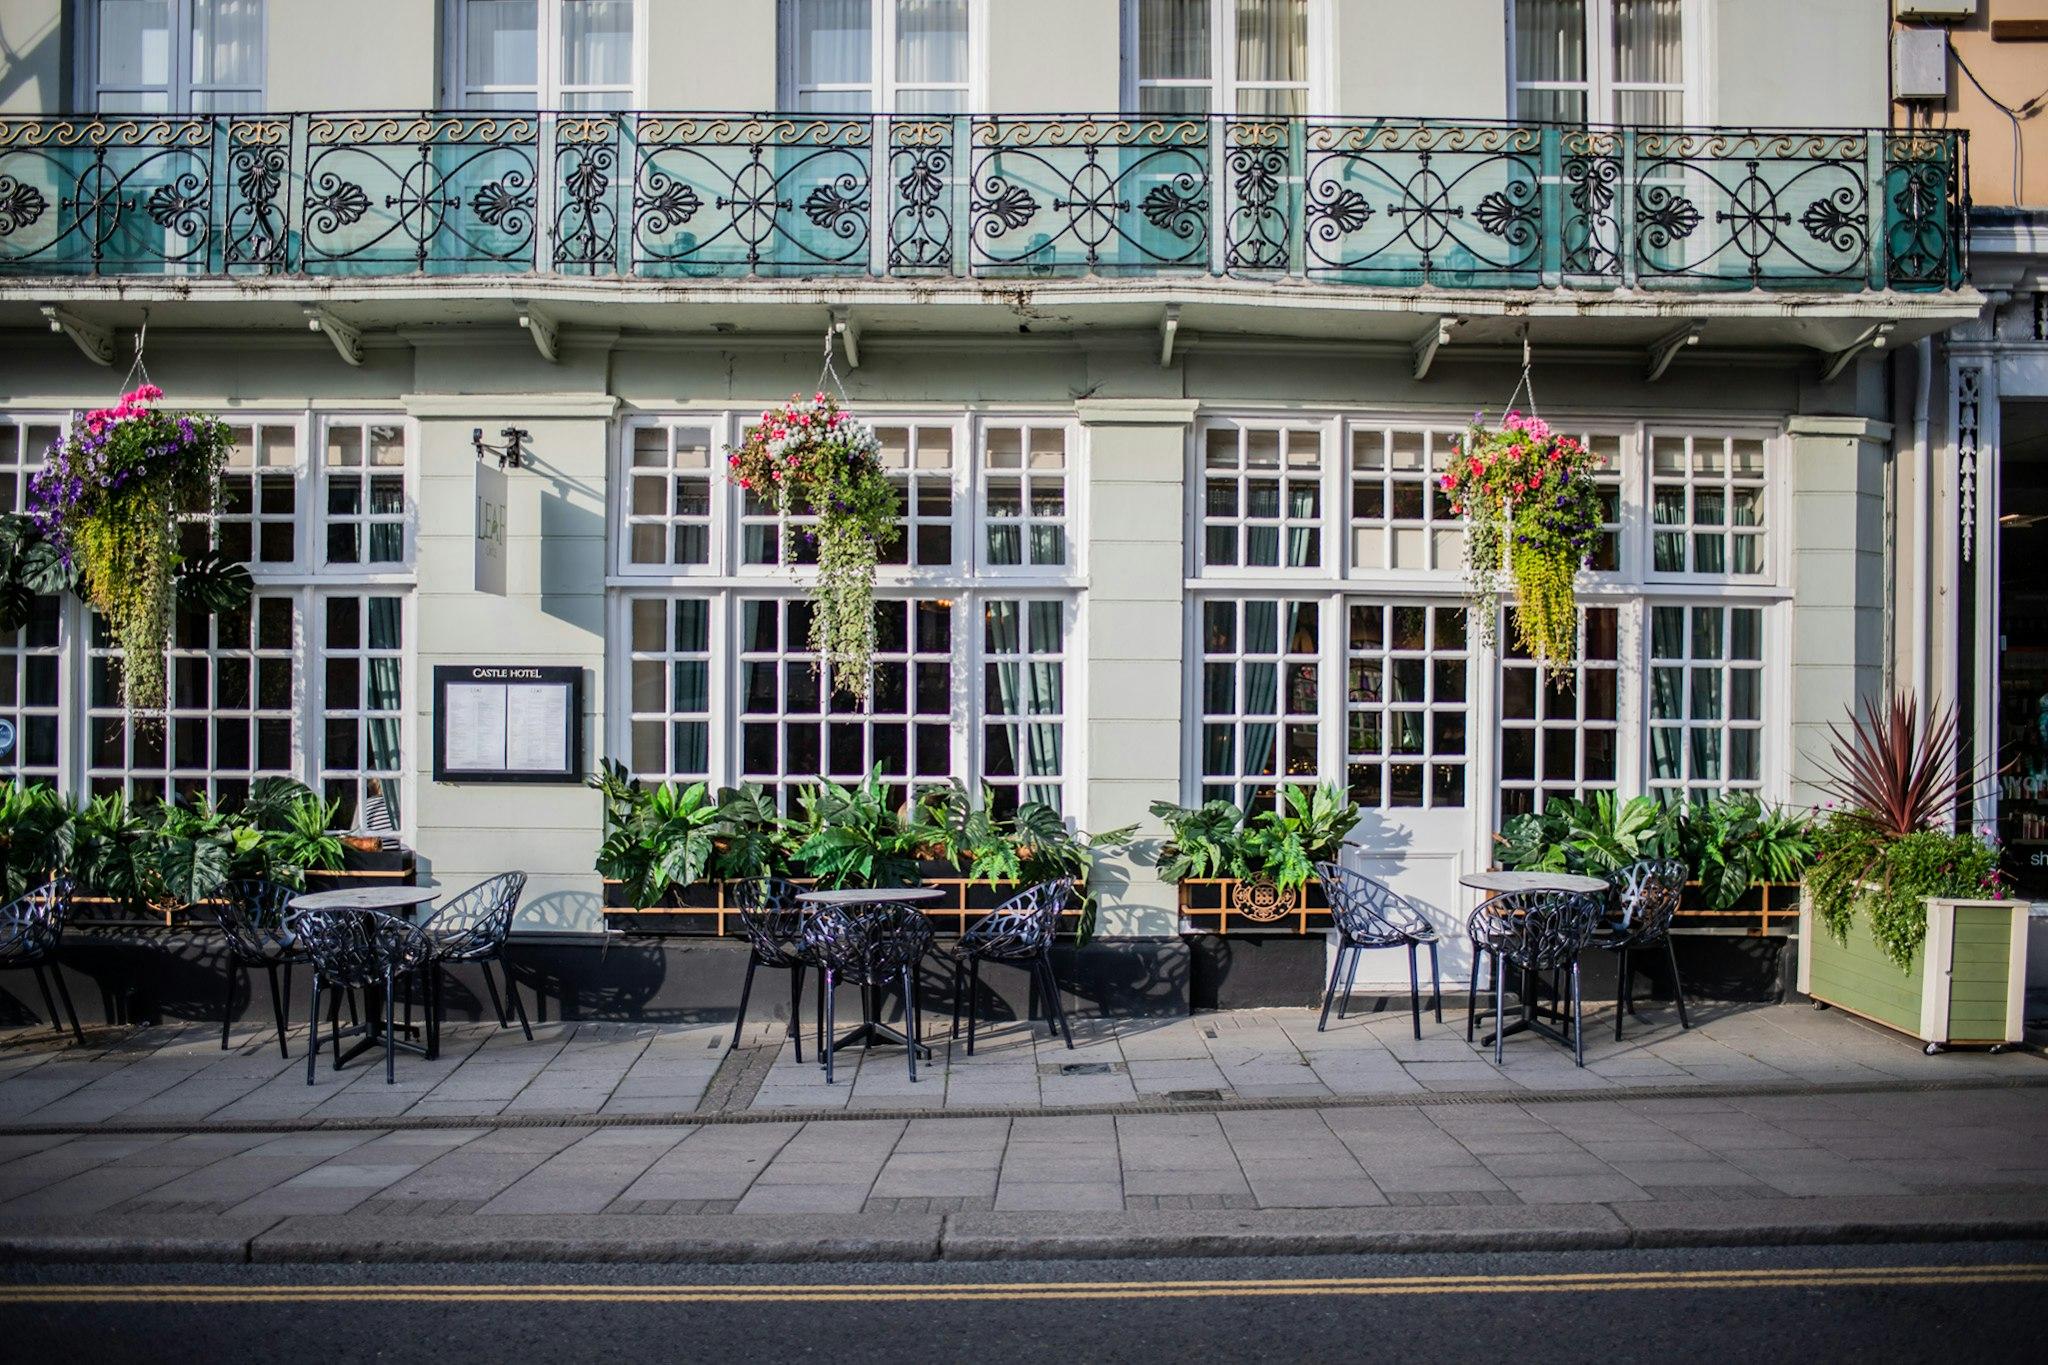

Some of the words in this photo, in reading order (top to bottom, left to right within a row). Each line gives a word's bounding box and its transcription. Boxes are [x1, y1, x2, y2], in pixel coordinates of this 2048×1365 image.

[478, 496, 505, 545] LEAF
[473, 668, 507, 678] CASTLE
[510, 669, 542, 678] HOTEL
